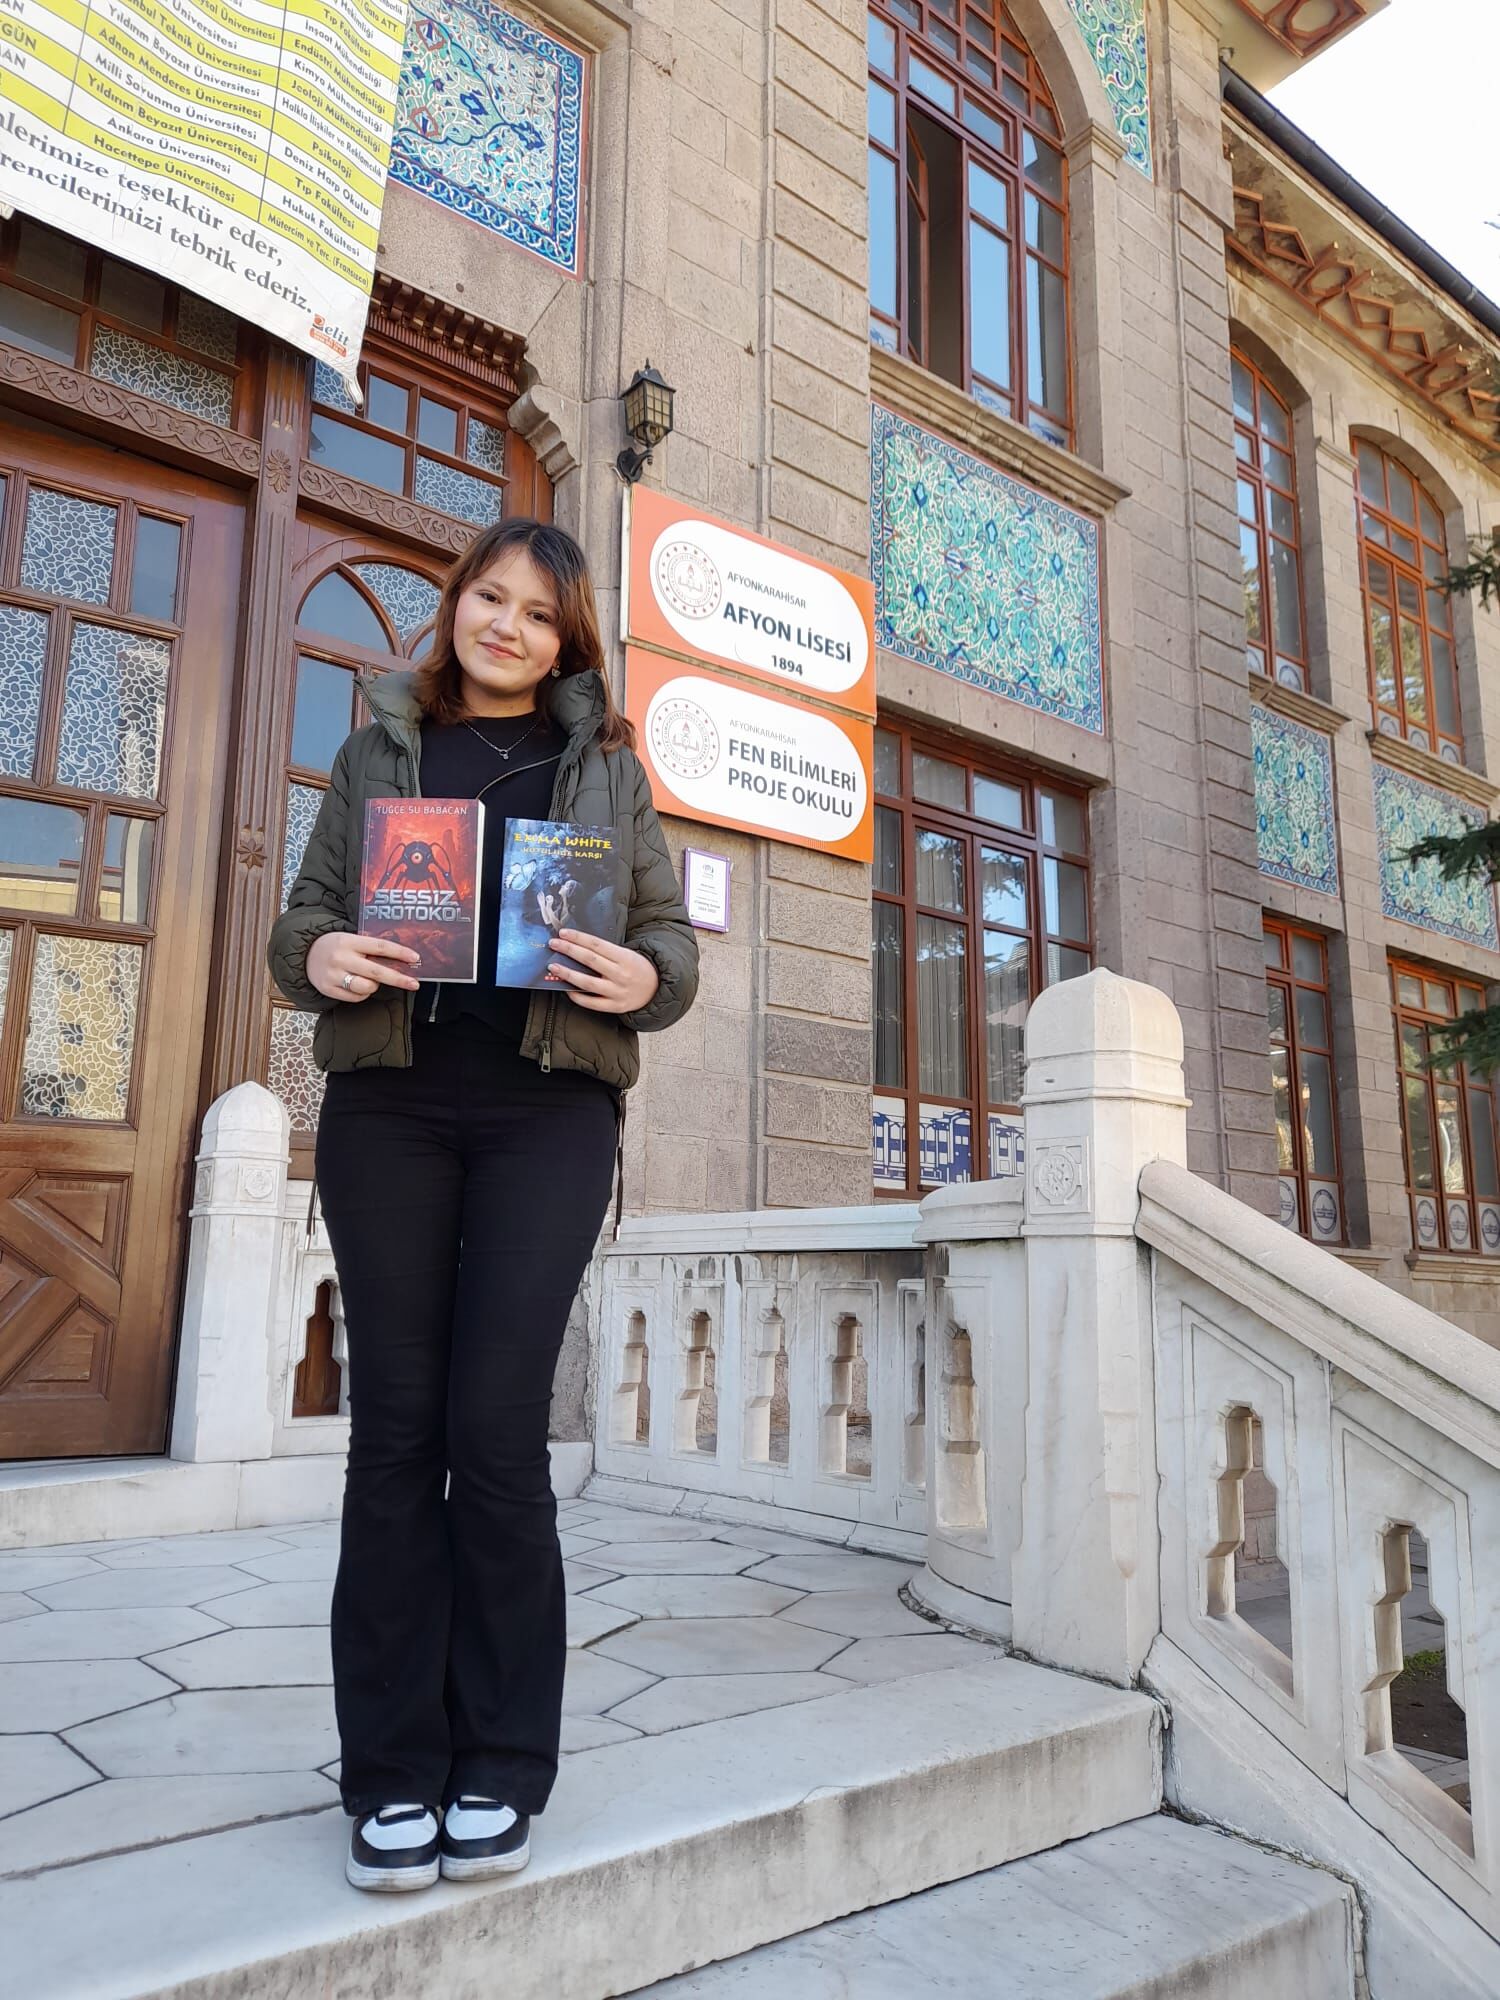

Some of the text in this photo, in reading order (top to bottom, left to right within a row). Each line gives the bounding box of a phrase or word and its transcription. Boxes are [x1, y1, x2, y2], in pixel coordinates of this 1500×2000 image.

[0, 19, 37, 51] GÜN
[108, 3, 260, 97] Yıldırım Beyazıt Üniversitesi
[159, 13, 193, 49] Teknik
[196, 43, 262, 77] Üniversitesi
[220, 8, 276, 41] Üniversitesi
[323, 9, 371, 58] Tıp Fakültesi
[380, 18, 398, 32] ATT
[98, 28, 262, 119] Adnan Menderes Üniversitesi
[294, 39, 386, 115] Endüstri Mühendisliği
[335, 41, 381, 88] Mühendisliği
[88, 72, 257, 164] Yıldırım Beyazıt Üniversitesi
[95, 52, 257, 140] Milli Savunma Üniversitesi
[291, 79, 381, 153] Jeoloji Mühendisliği
[294, 58, 383, 133] Kimya Mühendisliği
[107, 117, 231, 174] Ankara Üniversitesi
[282, 97, 308, 120] Halkla
[336, 136, 345, 147] ve
[346, 141, 382, 178] Reklamcılık
[312, 141, 352, 178] Psikoloji
[93, 134, 235, 203] Hacettepe Üniversitesi
[284, 146, 369, 216] Deniz Harp Okulu
[118, 173, 223, 231] teşekkür
[229, 224, 283, 267] eder,
[267, 213, 305, 241] Mütercim
[306, 236, 315, 248] ve
[282, 195, 360, 257] Hukuk Fakültesi
[294, 177, 355, 230] Tıp Fakültesi
[170, 227, 237, 274] tebrik
[244, 267, 312, 314] ederiz.
[728, 571, 806, 608] AFYONKARAHİSAR
[723, 601, 851, 663] AFYON LİSESİ
[772, 655, 803, 676] 1894
[729, 719, 797, 746] AFYONKARAHİSAR
[728, 767, 852, 818] PROJE OKULU
[729, 738, 856, 793] FEN BİLİMLERİ
[376, 805, 467, 815] TUĞÇE SU BABACAN
[514, 833, 560, 845] EMMA
[364, 904, 471, 922] PROTOKOL
